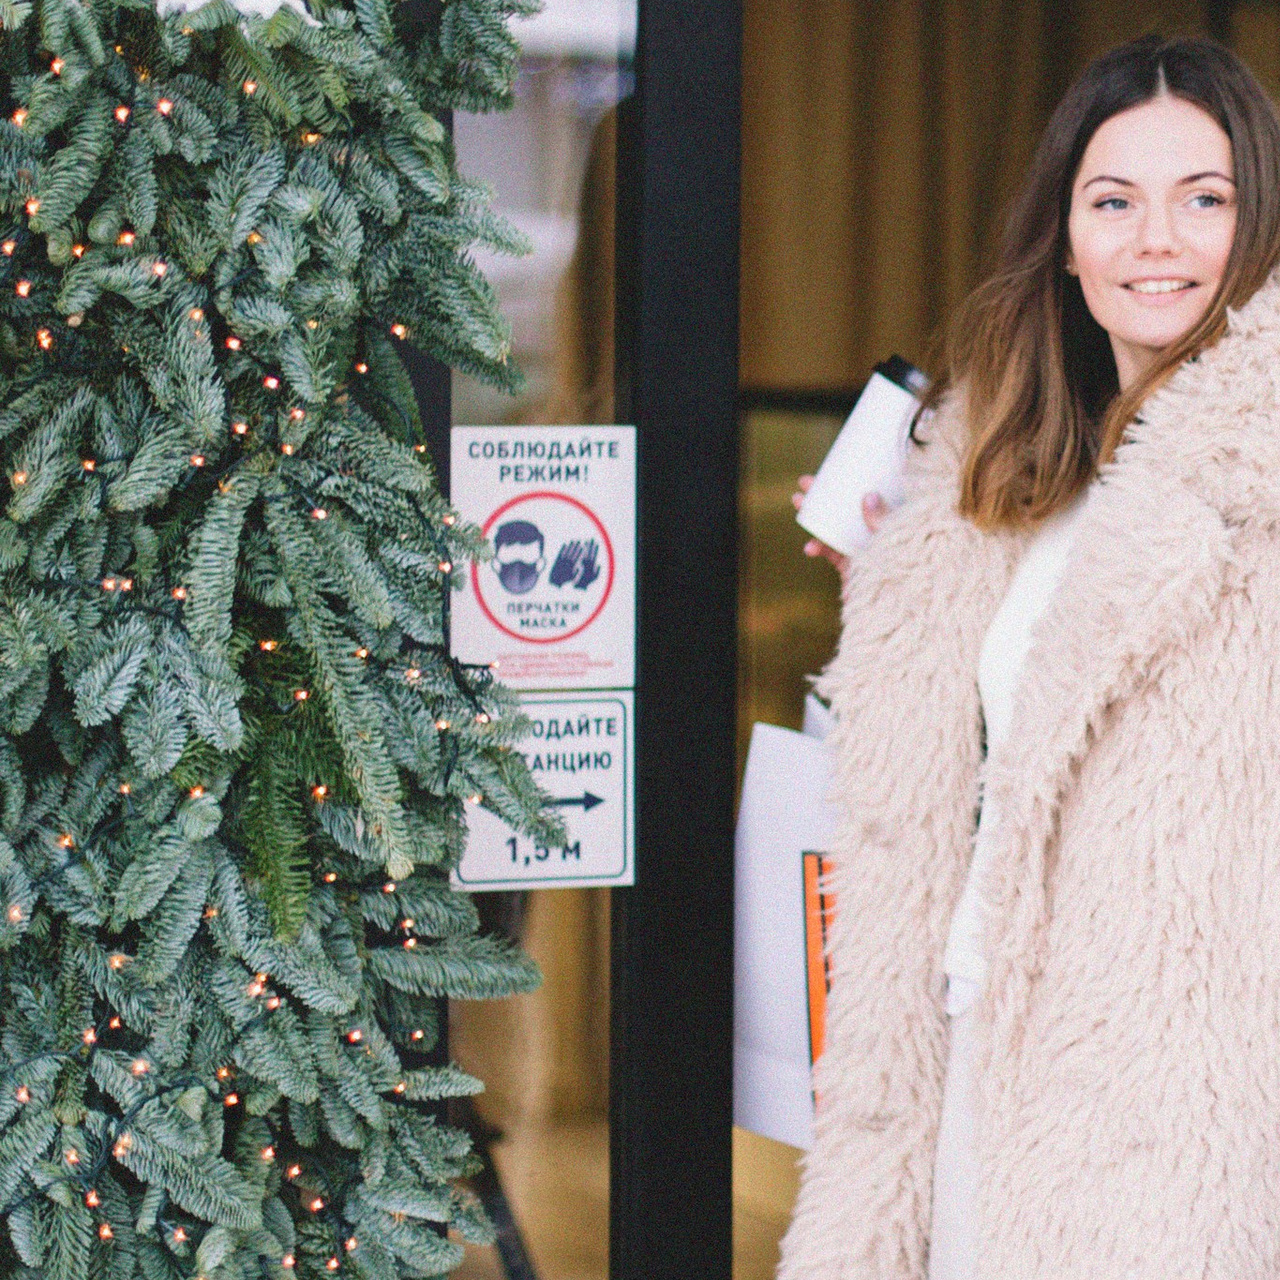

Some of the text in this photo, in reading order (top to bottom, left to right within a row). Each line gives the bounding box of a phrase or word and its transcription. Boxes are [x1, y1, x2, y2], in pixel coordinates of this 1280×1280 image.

[468, 437, 620, 461] СОБЛЮДАЙТЕ
[499, 464, 589, 483] РЕЖИМ!
[506, 601, 581, 614] ПЕРЧАТКИ
[518, 617, 568, 629] МАСКА
[506, 837, 550, 867] 1,5
